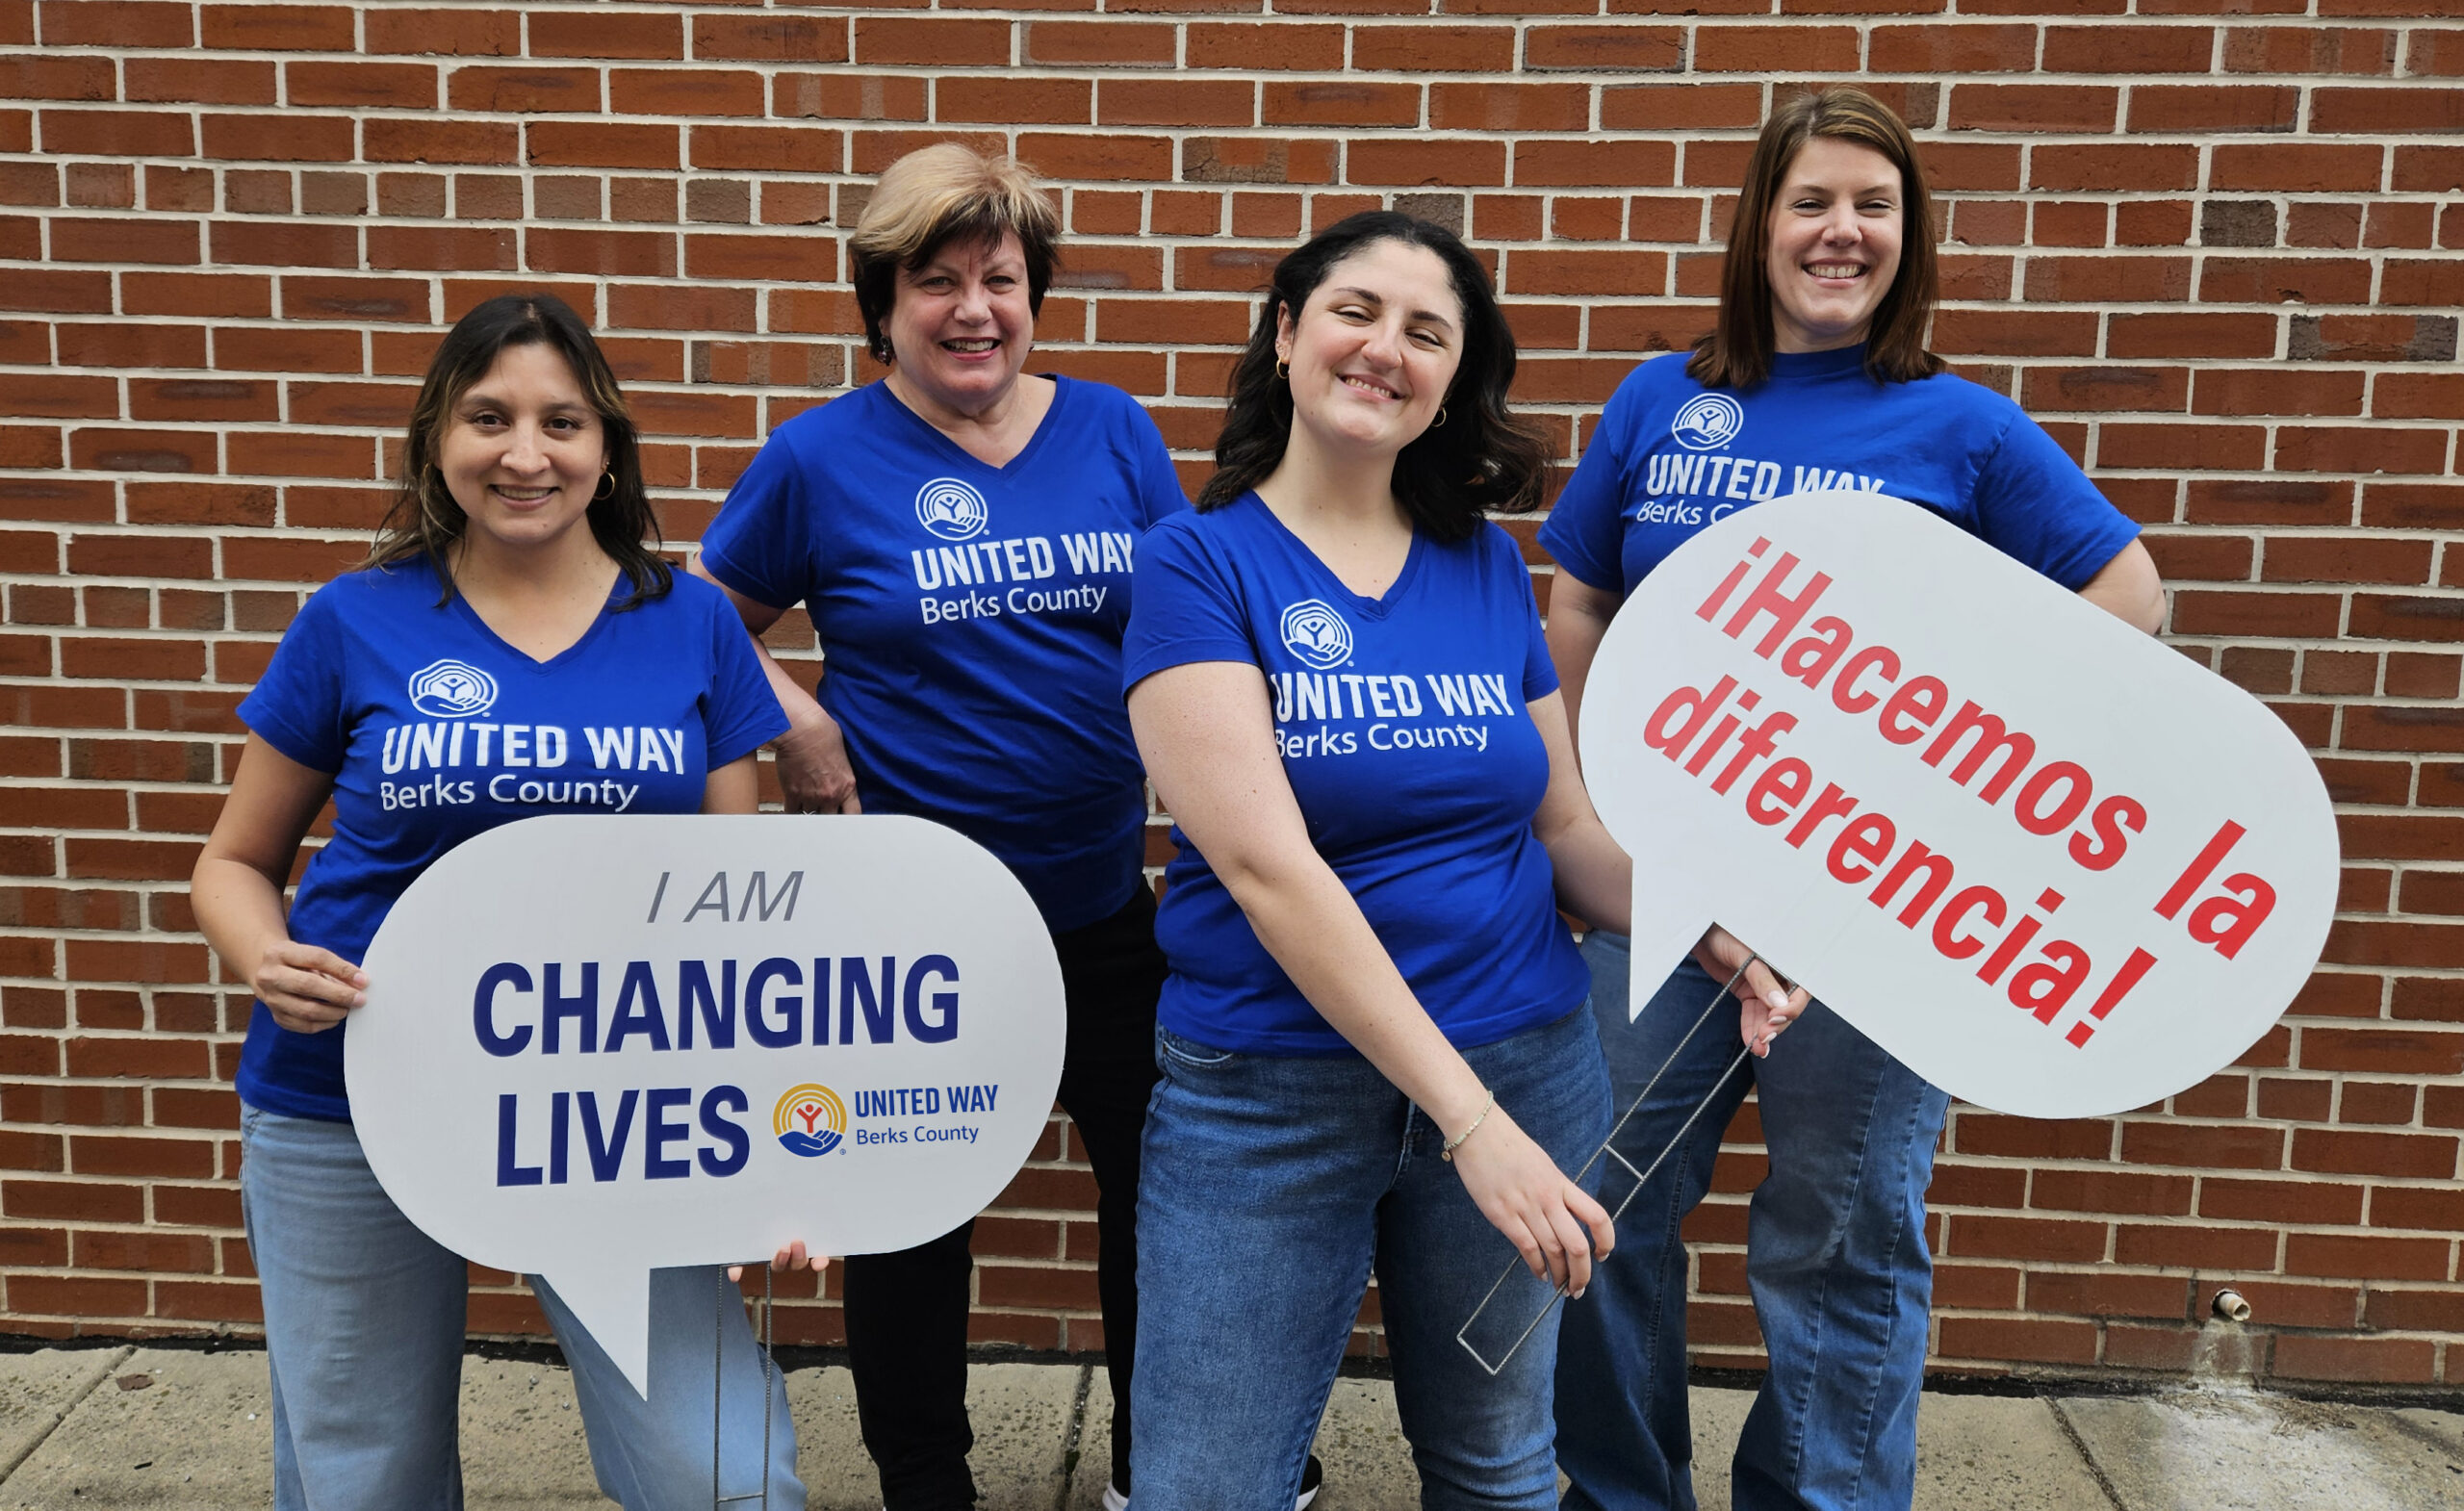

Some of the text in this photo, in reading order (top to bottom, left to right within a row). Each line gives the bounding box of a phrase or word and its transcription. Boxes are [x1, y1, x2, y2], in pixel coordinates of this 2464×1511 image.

[1646, 453, 1782, 502] UNITED
[1636, 499, 1704, 525] Berks
[911, 531, 1134, 591] UNITED WAY
[919, 583, 1108, 626] Berks County
[1270, 672, 1515, 723] UNITED WAY
[382, 722, 684, 775] UNITED WAY
[1275, 724, 1488, 758] Berks County
[1694, 535, 2278, 962] ¡Hacemos la
[381, 774, 639, 812] Berks County
[1642, 673, 2159, 1051] diferencia!
[646, 870, 805, 924] I AM
[473, 954, 961, 1058] CHANGING
[855, 1084, 998, 1117] UNITED WAY
[496, 1085, 751, 1188] LIVES
[856, 1125, 980, 1145] Berks County
